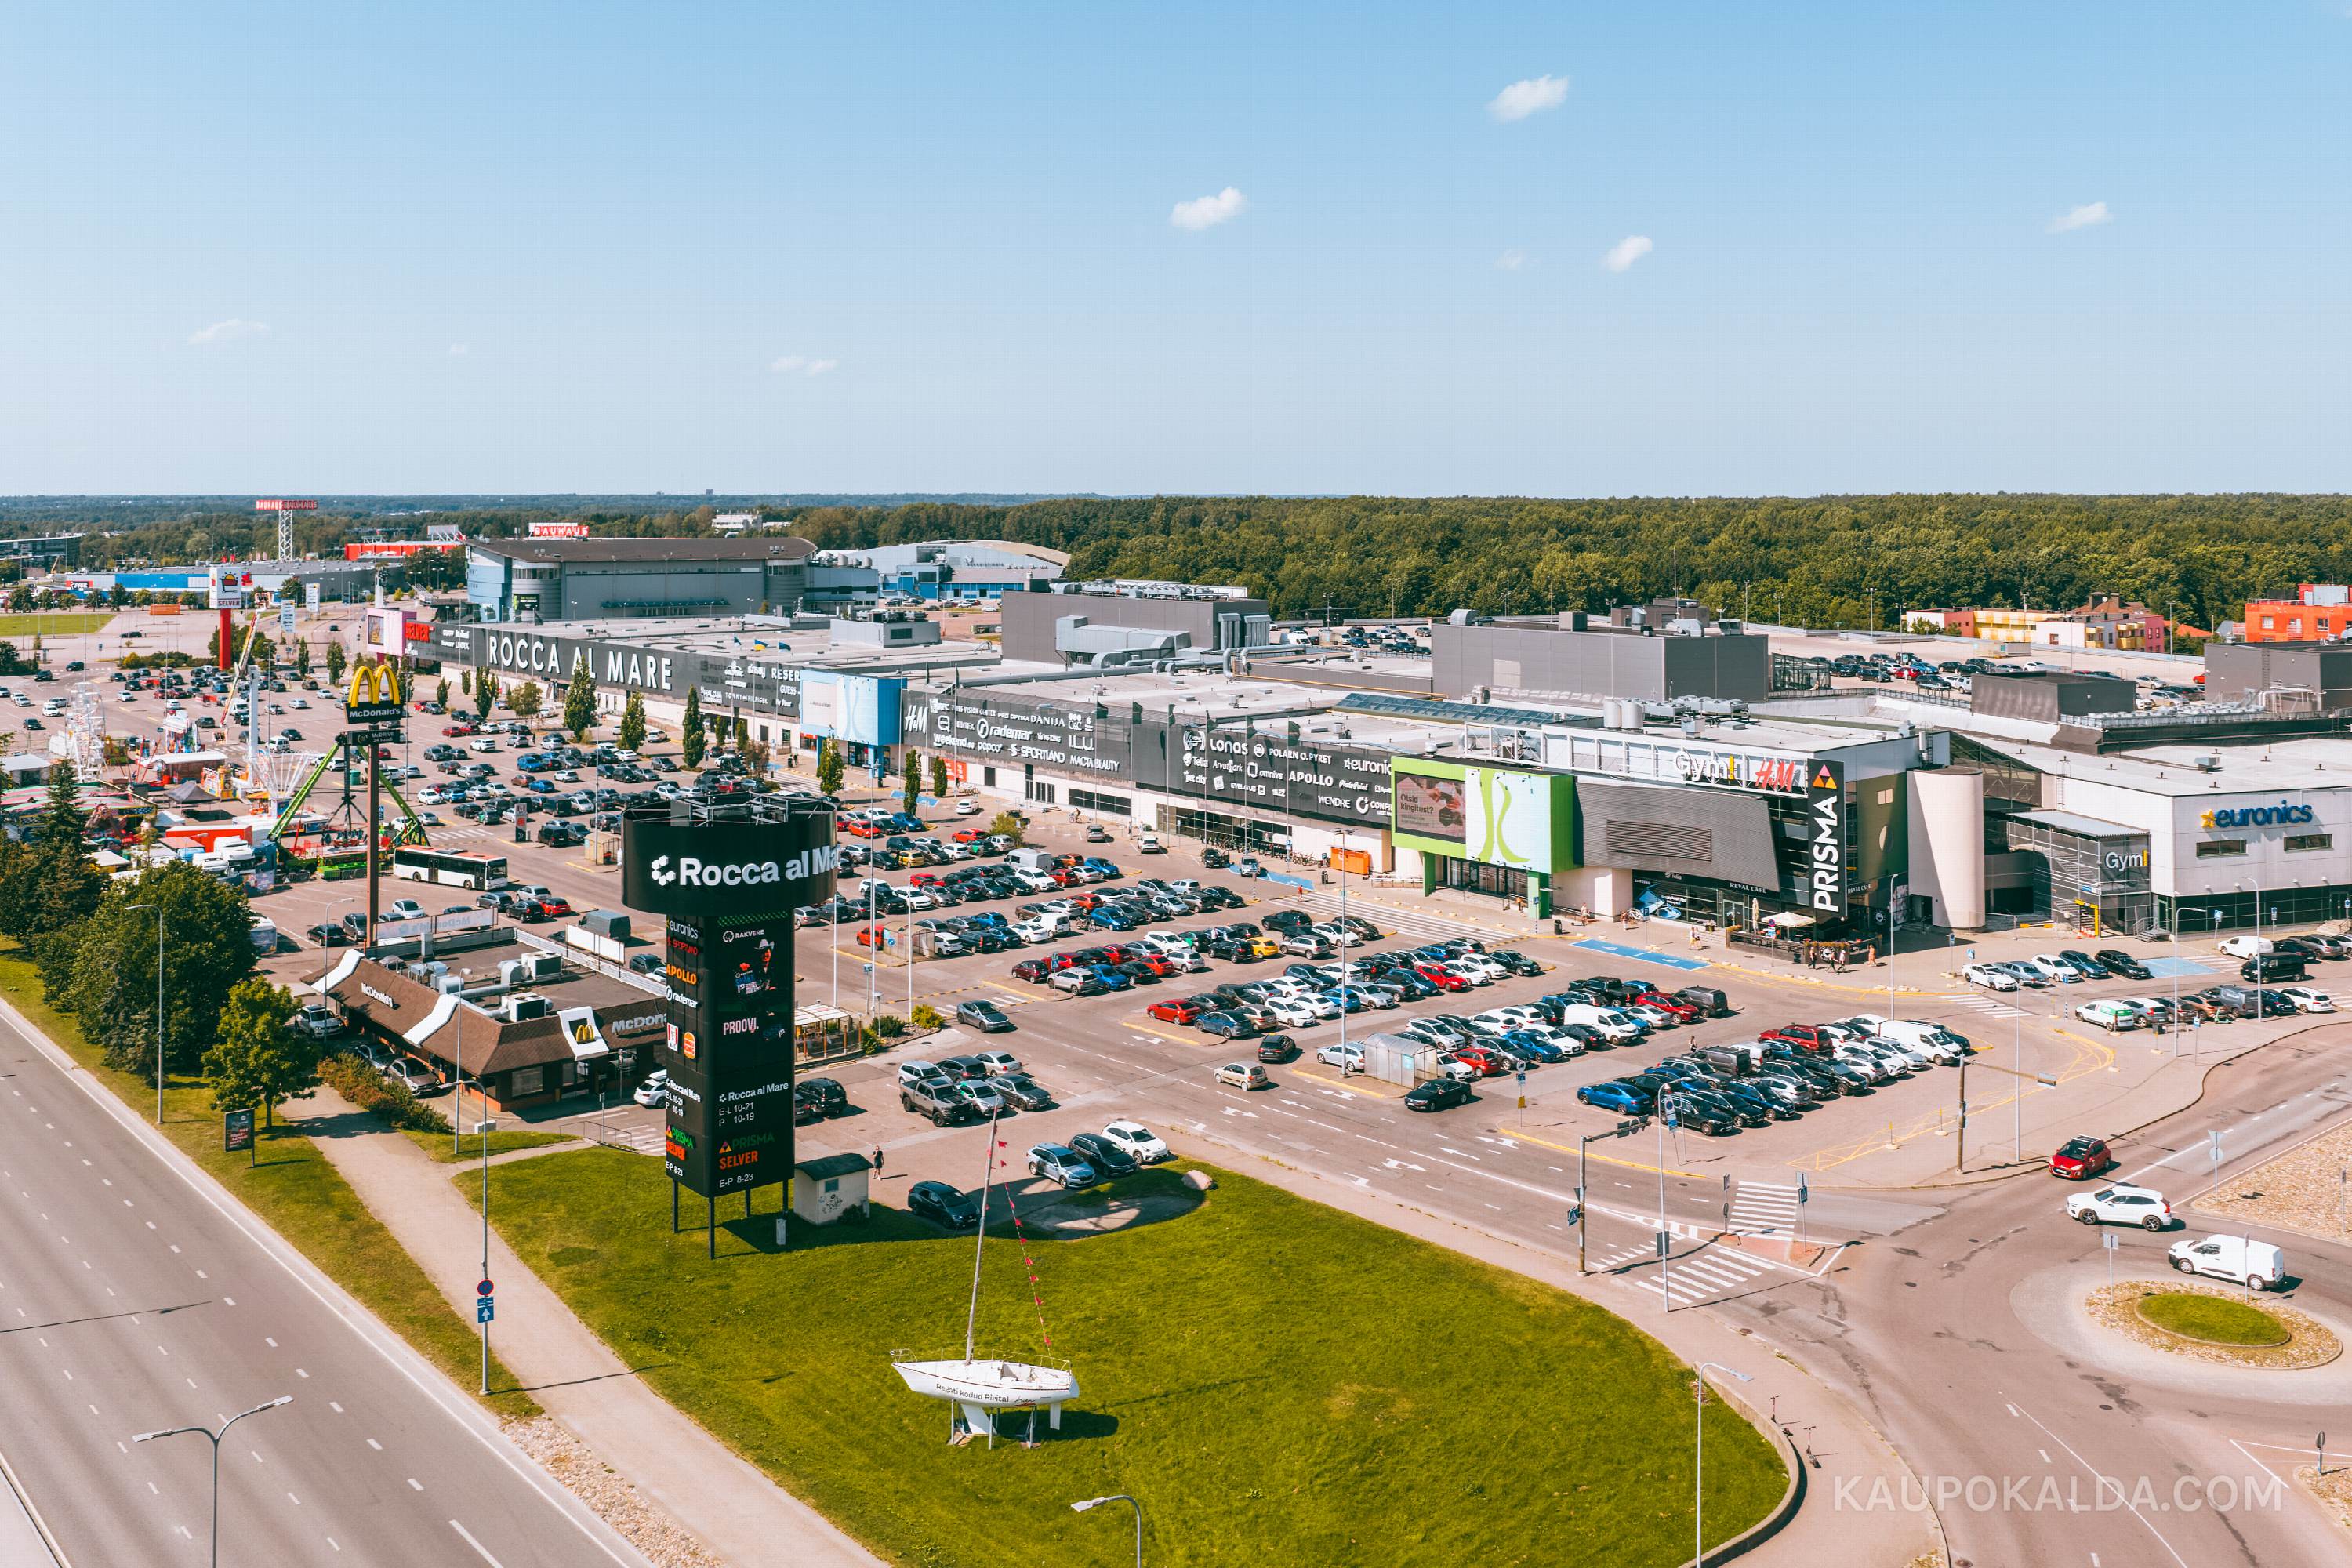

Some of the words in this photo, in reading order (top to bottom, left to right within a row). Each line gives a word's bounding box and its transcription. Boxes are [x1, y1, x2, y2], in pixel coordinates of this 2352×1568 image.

[535, 527, 588, 536] BAUHAUS
[489, 636, 561, 674] ROCCA
[572, 646, 596, 679] AL
[607, 650, 672, 690] MARE
[350, 708, 401, 718] McDonald's
[1030, 715, 1065, 728] DANIJA
[990, 725, 1033, 742] rademar
[1021, 746, 1065, 764] SPORTLAND
[1192, 756, 1208, 768] Telia
[1269, 748, 1299, 760] POLARN
[1309, 753, 1332, 764] PYRET
[1094, 758, 1120, 772] BEAUTY
[1259, 770, 1283, 780] omniva
[1288, 771, 1334, 787] APOLLO
[1755, 759, 1795, 793] H&M
[1318, 795, 1351, 809] WENDRE
[1400, 793, 1417, 804] Otsid
[1400, 803, 1434, 815] kingitust?
[2214, 800, 2313, 828] euronics
[1813, 794, 1839, 913] PRISMA
[2106, 849, 2148, 871] Gym!
[679, 858, 780, 886] Rocca
[786, 851, 808, 880] al
[1730, 882, 1749, 891] REVAL
[670, 920, 699, 939] euronics
[735, 929, 764, 939] RAKVERE
[666, 964, 697, 985] APOLLO
[672, 991, 698, 1009] rademar
[723, 1017, 759, 1036] PROOVI.
[728, 1089, 756, 1102] Rocca
[757, 1085, 765, 1095] al
[766, 1083, 789, 1094] Mare
[719, 1106, 732, 1116] E-L
[734, 1102, 753, 1112] 10-21
[734, 1112, 754, 1123] 10-19
[672, 1127, 694, 1150] PRISMA
[732, 1131, 775, 1149] PRISMA
[719, 1150, 760, 1170] SELVER
[719, 1178, 733, 1188] E-P
[736, 1173, 753, 1184] 8-23
[960, 1390, 983, 1399] kodud
